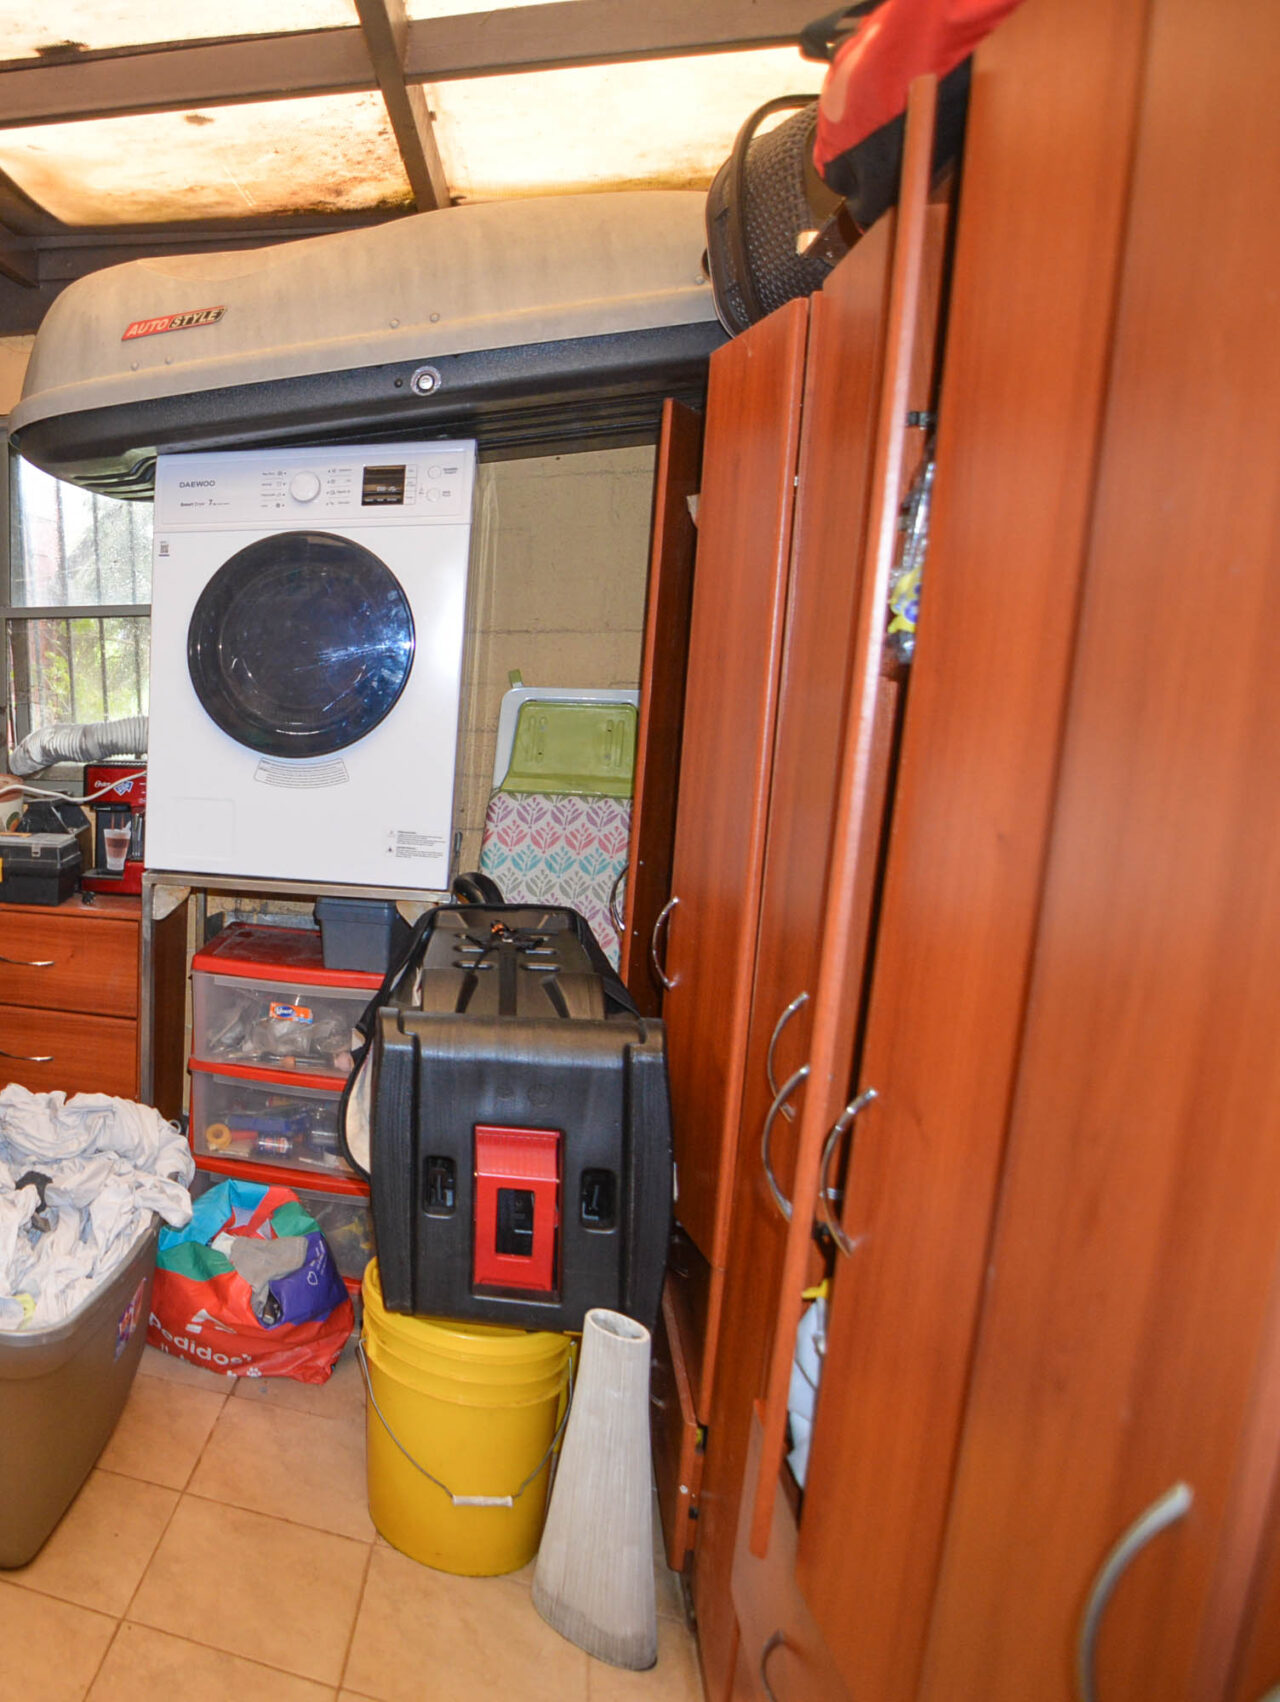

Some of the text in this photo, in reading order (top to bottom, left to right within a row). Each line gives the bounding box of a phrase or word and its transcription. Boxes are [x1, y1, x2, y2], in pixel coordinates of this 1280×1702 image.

[127, 309, 218, 336] AUTO STYLE
[179, 480, 216, 488] DAEWOO
